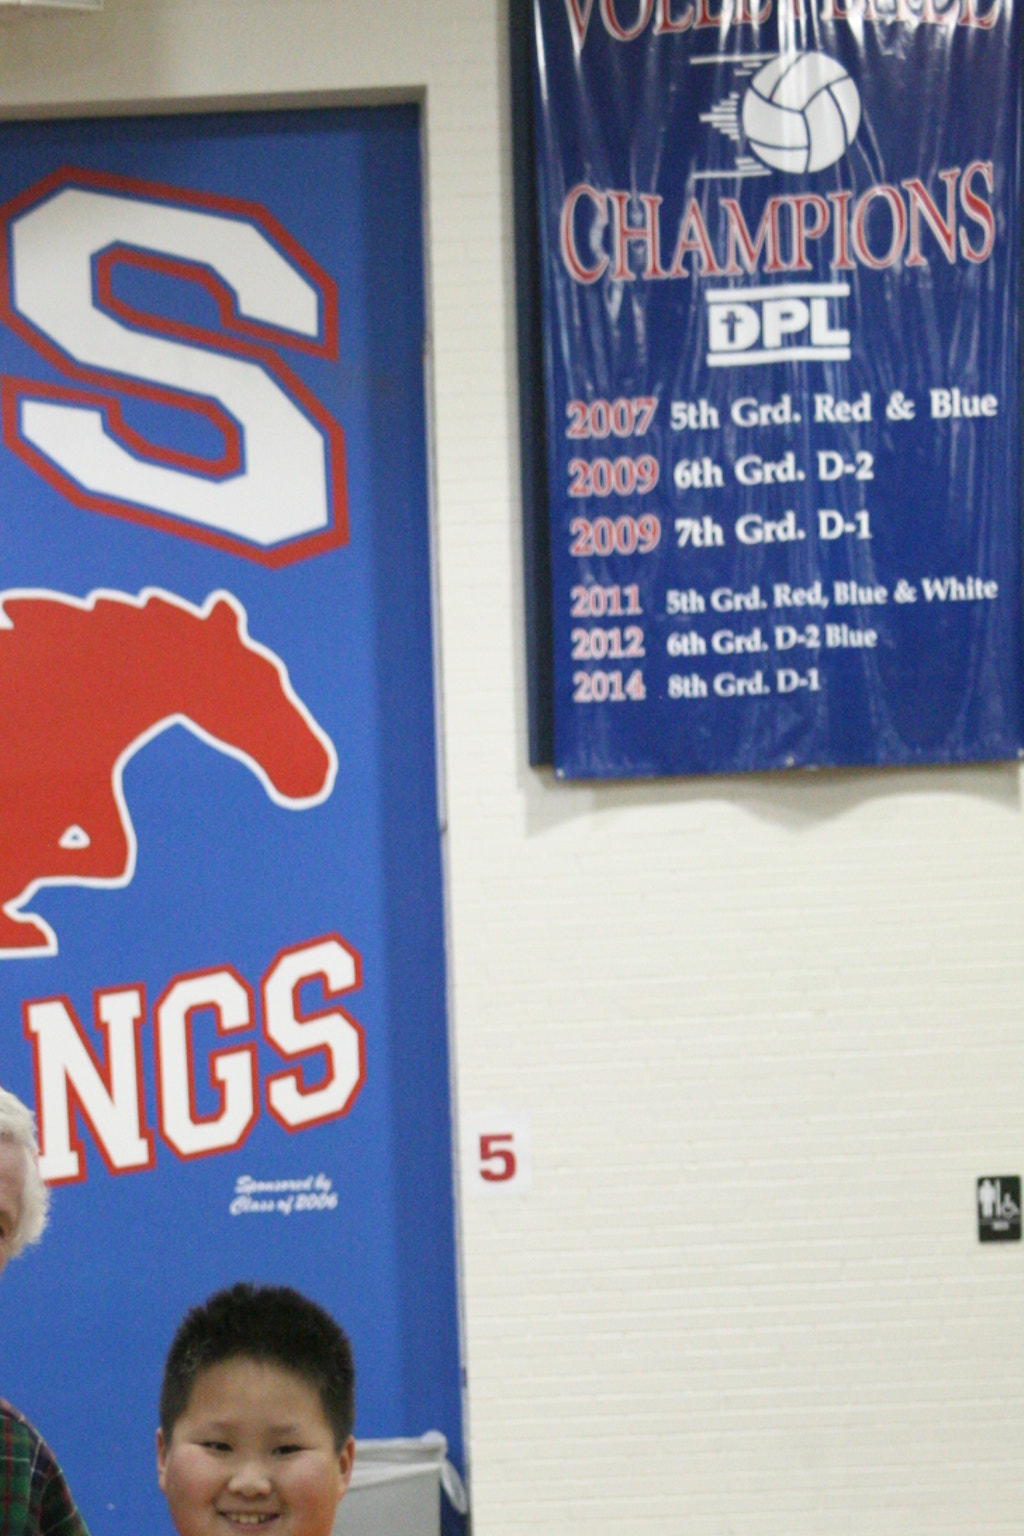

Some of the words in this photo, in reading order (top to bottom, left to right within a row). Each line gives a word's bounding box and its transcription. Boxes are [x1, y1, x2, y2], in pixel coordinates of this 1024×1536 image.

[560, 160, 995, 284] CHAMPIONS
[708, 298, 850, 352] DPL
[566, 397, 658, 439] 2007
[671, 400, 720, 431] 5th
[732, 395, 801, 429] Grd.
[814, 393, 872, 423] Red
[886, 392, 916, 420] &
[929, 388, 999, 419] Blue
[568, 455, 659, 497] 2009
[674, 459, 724, 490] 6th
[735, 453, 805, 486] Grd.
[817, 450, 875, 481] D-2
[569, 514, 660, 556] 2009
[674, 517, 725, 548] 7th
[735, 511, 806, 545] Grd.
[818, 510, 873, 540] D-1
[570, 585, 643, 617] 2011
[666, 589, 705, 615] 5th
[711, 585, 767, 612] Grd.
[774, 581, 829, 611] Red,
[834, 580, 887, 605] Blue
[894, 579, 917, 603] &
[922, 575, 999, 601] White
[571, 627, 645, 661] 2012
[667, 630, 706, 657] 6th
[712, 628, 768, 655] Grd.
[775, 625, 820, 650] D-2
[825, 623, 877, 648] Blue
[573, 670, 647, 703] 2014
[668, 673, 707, 699] 8th
[713, 671, 769, 697] Grd.
[777, 668, 821, 693] D-1
[478, 1132, 518, 1183] 5
